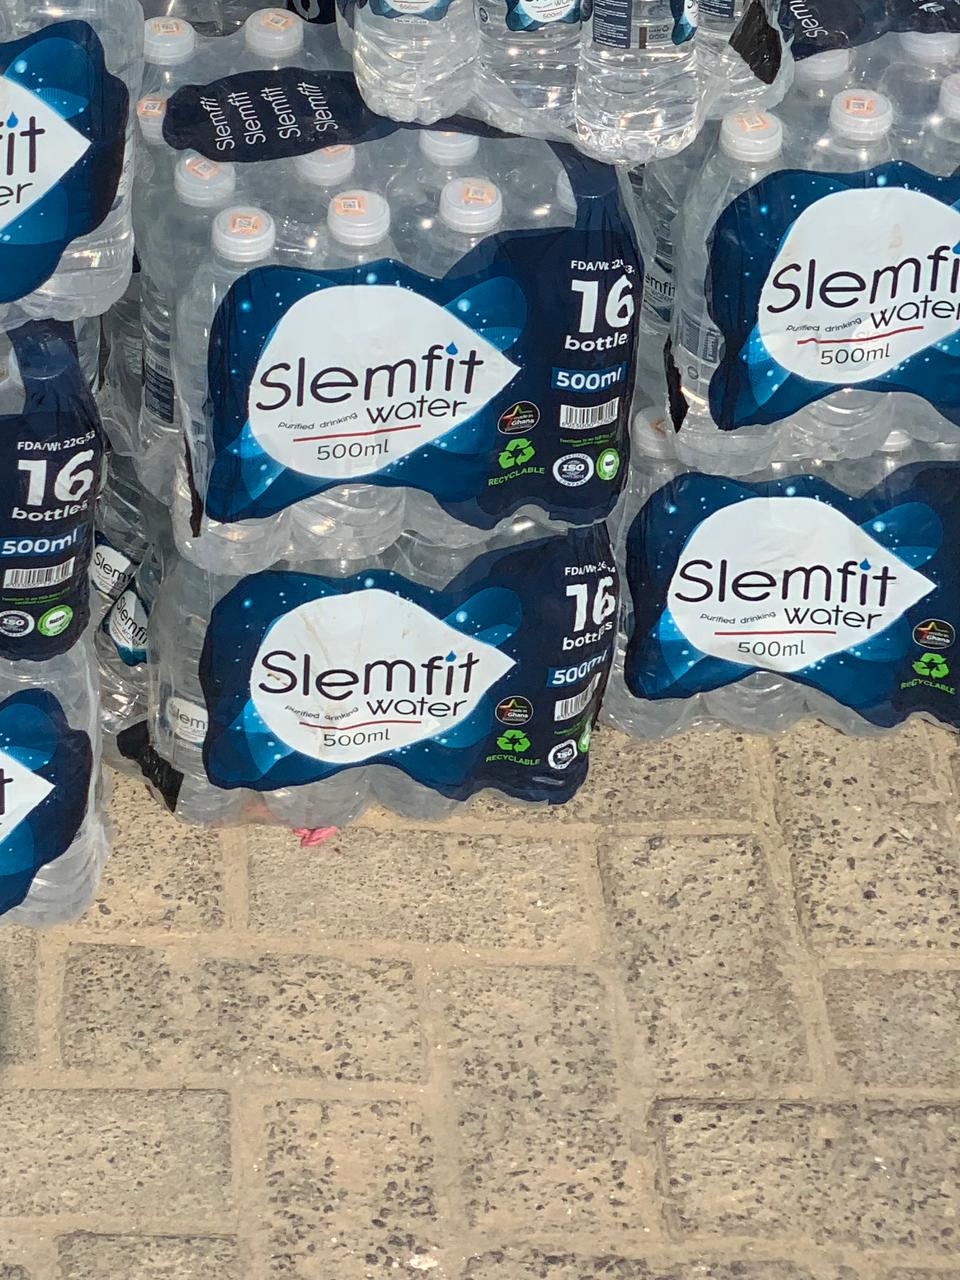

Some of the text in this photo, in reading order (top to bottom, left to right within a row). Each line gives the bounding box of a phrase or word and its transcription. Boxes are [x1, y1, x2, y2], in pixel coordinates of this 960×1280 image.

[227, 91, 266, 146] Slemfit
[261, 87, 301, 141] Slemfit
[297, 81, 340, 133] Slemfit
[200, 95, 235, 152] Slemfit
[767, 245, 960, 313] Slemfi
[571, 275, 635, 334] 16
[786, 316, 862, 333] purified drinking
[564, 332, 629, 352] bottle
[820, 343, 891, 366] 500ml
[255, 342, 484, 411] Slemfit
[555, 368, 622, 392] 500ml
[278, 411, 358, 431] purified drinking
[366, 395, 468, 425] water
[511, 418, 535, 426] Ghana
[17, 430, 96, 452] FDA/Wt 22G-53
[316, 439, 390, 462] 500ml
[17, 449, 95, 506] 16
[488, 466, 545, 487] RECYCLABLE
[561, 463, 585, 472] ISO
[11, 499, 88, 521] bottles
[1, 528, 77, 555] 500ml
[674, 558, 897, 607] Slemfit
[566, 576, 616, 633] 16
[2, 618, 25, 627] ISO
[700, 610, 776, 624] purified drinking
[784, 604, 883, 630] water
[737, 640, 806, 658] 500ml
[926, 634, 951, 644] Ghana
[258, 648, 480, 701] Slemfit
[552, 649, 607, 686] 500ml
[900, 678, 956, 696] RECYCLABLE
[284, 704, 359, 721] purified drinking
[367, 696, 468, 718] water
[323, 729, 390, 748] 500ml
[485, 754, 541, 767] RECYCLABLE
